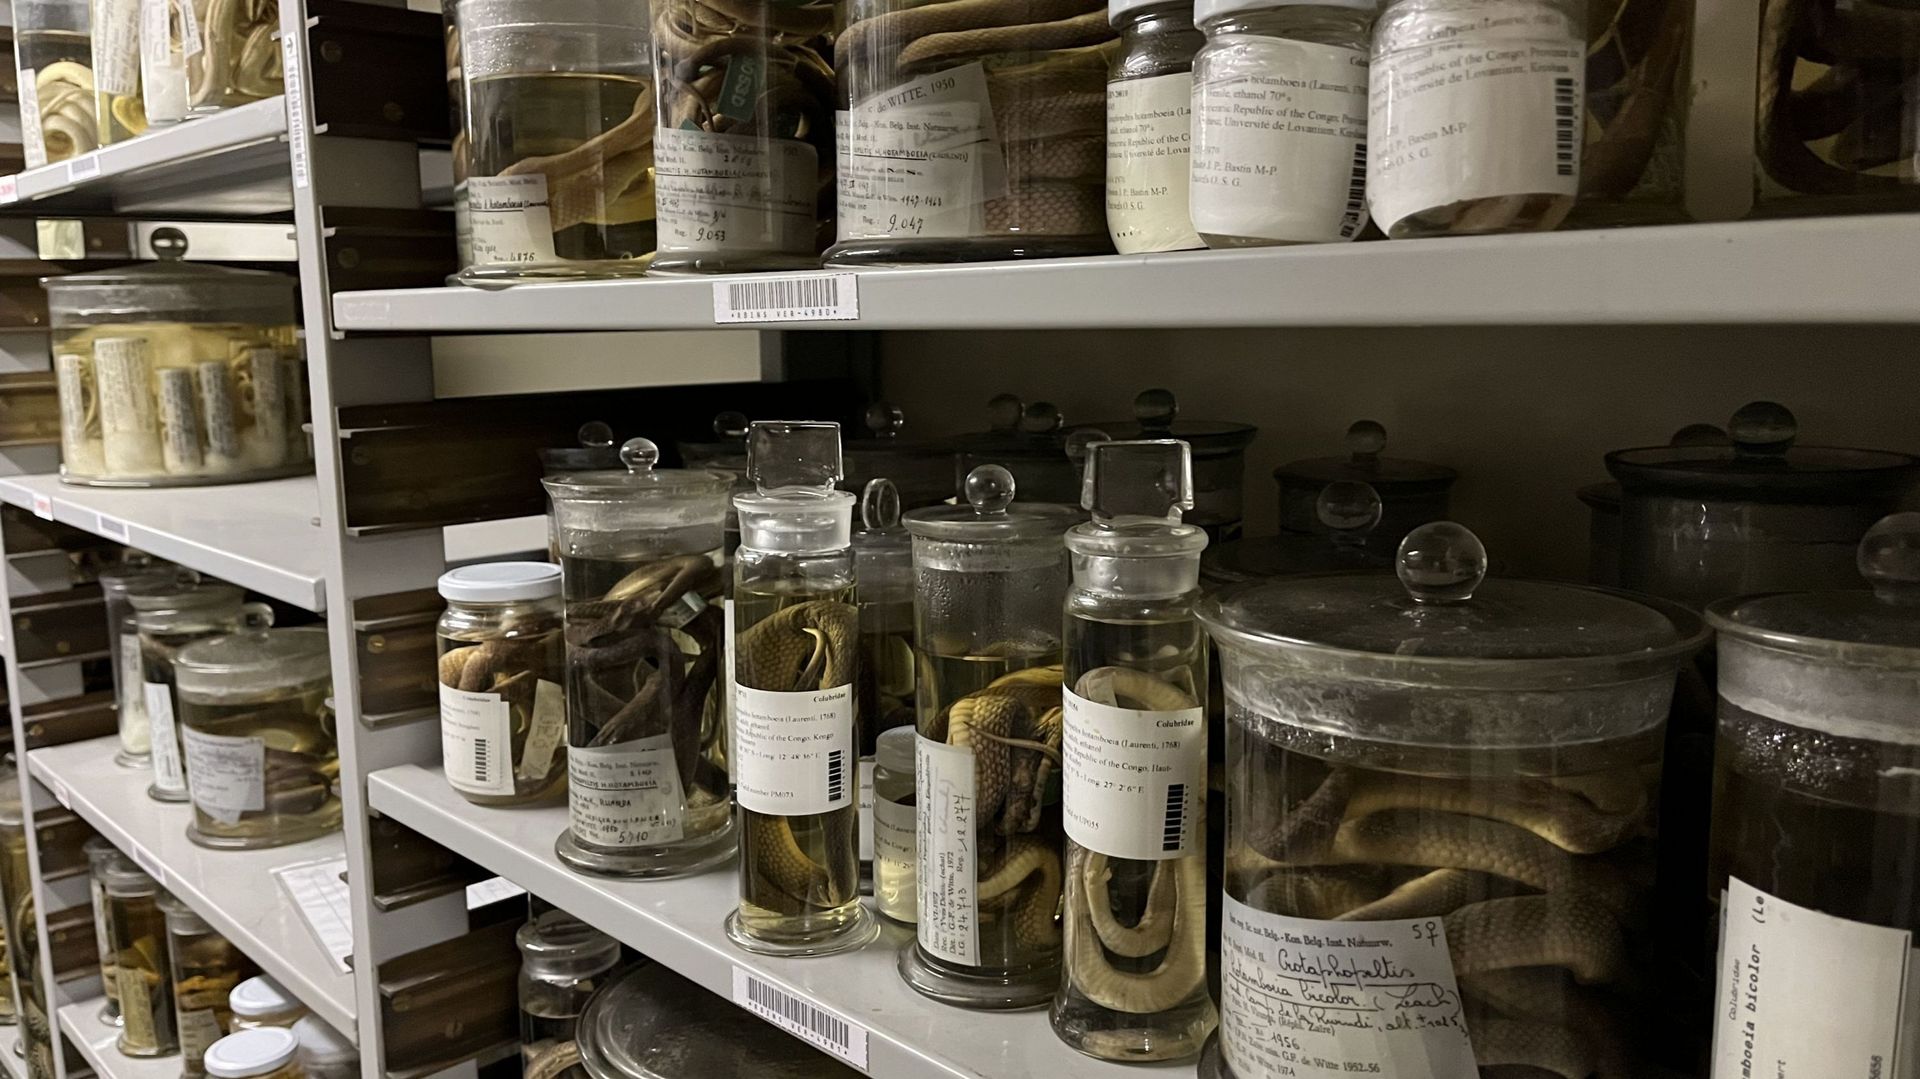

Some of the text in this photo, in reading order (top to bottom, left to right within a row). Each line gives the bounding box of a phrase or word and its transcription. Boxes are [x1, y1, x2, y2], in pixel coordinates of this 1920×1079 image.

[1276, 108, 1287, 117] of
[1290, 108, 1305, 119] the
[1272, 121, 1285, 130] de
[1156, 719, 1195, 729] Colubridae
[1108, 760, 1120, 770] the
[947, 851, 955, 869] 1972
[1744, 943, 1762, 1014] bicolor
[1740, 1020, 1756, 1079] mboeia
